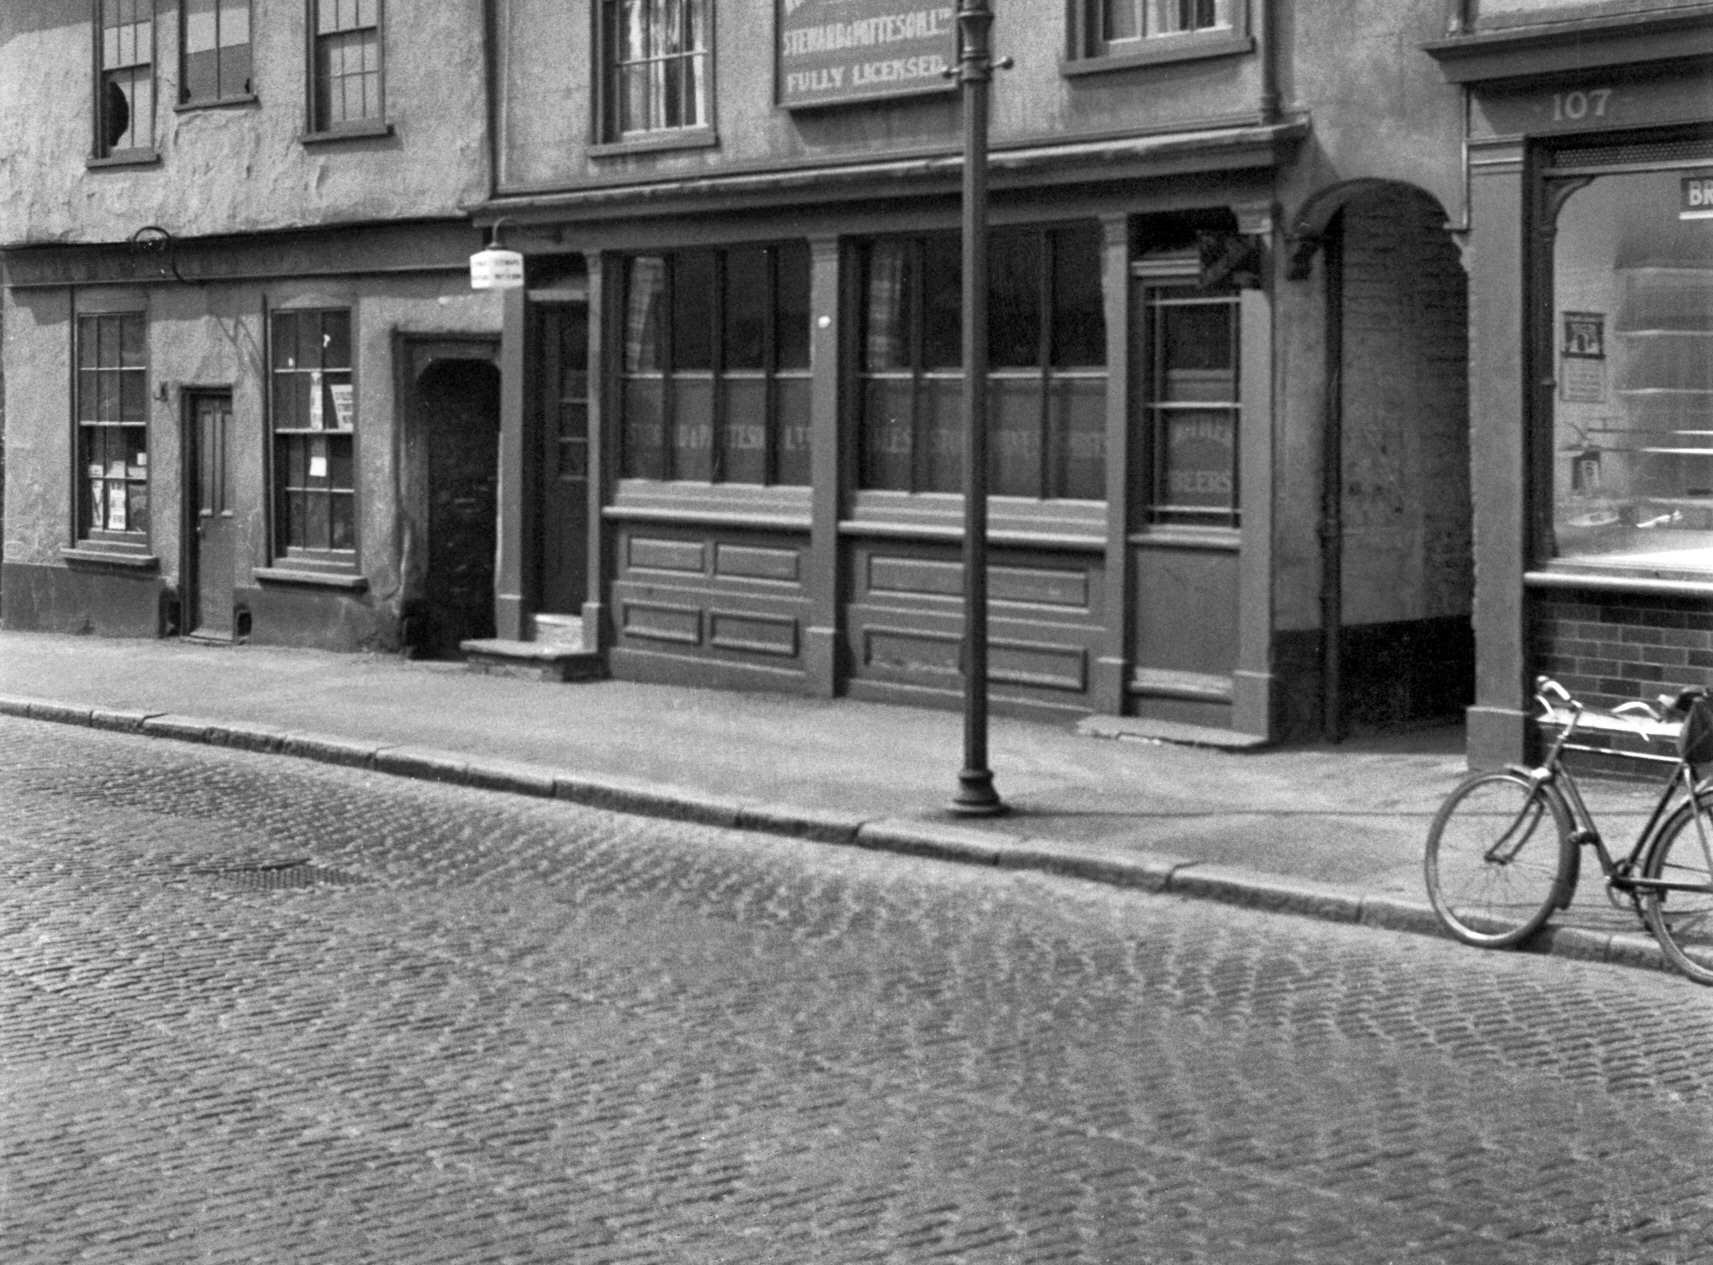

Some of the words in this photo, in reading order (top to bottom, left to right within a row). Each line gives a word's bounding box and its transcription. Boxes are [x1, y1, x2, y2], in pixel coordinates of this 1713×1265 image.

[787, 67, 845, 93] FULLY
[853, 54, 944, 86] LICENSED
[1553, 88, 1613, 122] 107
